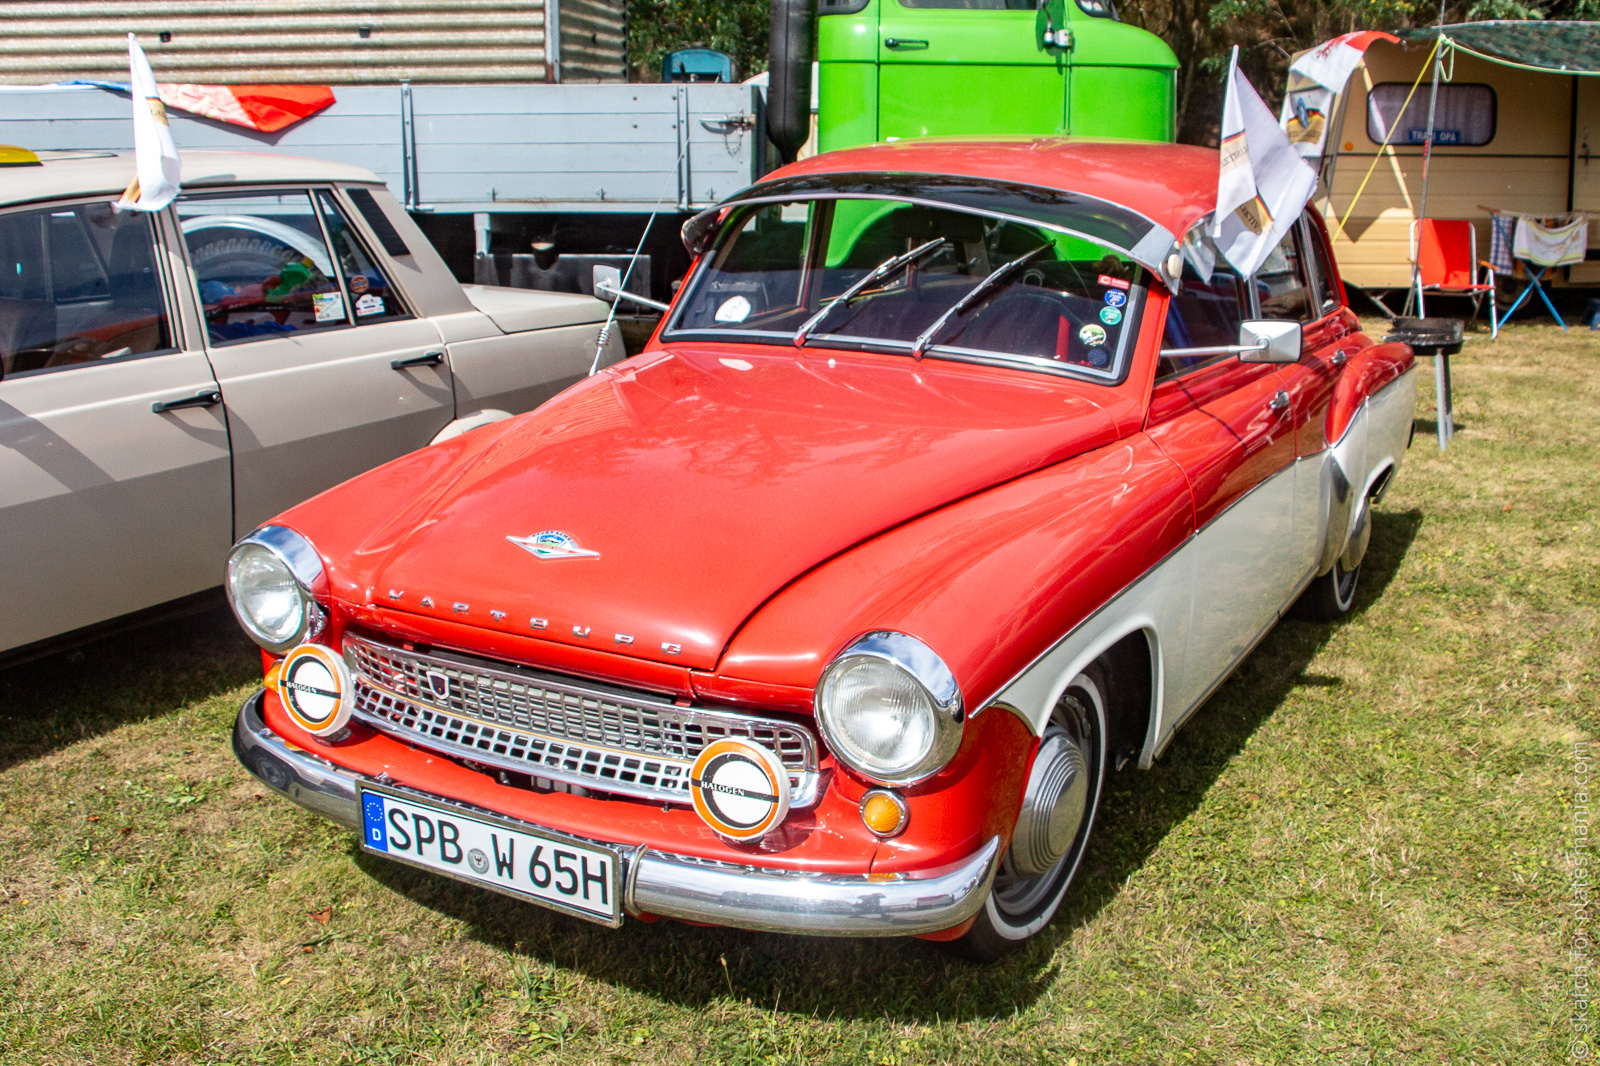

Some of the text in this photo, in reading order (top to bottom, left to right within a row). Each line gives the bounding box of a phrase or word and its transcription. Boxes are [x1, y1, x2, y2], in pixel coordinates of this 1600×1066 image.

[1412, 130, 1456, 141] TRAI OPA
[389, 589, 681, 656] WARTBURG
[286, 681, 317, 694] HALOGEN
[701, 781, 745, 796] HALOGEN
[372, 828, 382, 841] D
[388, 808, 608, 905] SPB W 65H
